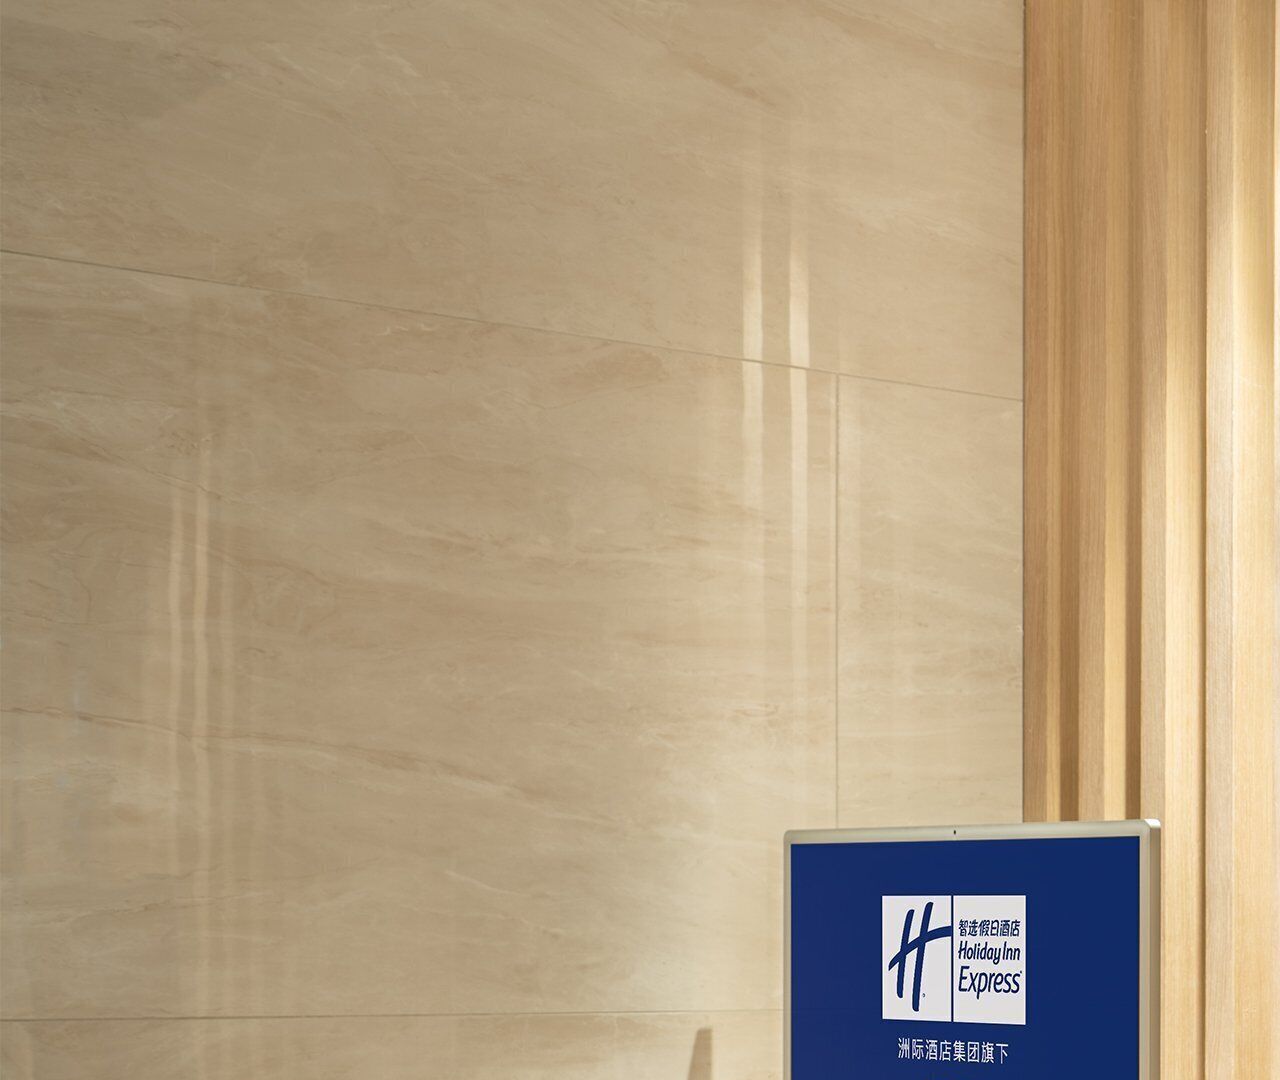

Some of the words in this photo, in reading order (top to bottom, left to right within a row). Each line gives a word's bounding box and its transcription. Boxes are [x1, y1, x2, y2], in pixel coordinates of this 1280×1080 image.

[958, 918, 1021, 938] 智选假日酒店
[958, 940, 1001, 965] Holiday
[1002, 941, 1021, 961] Inn
[958, 965, 1021, 1000] Express
[897, 1037, 1009, 1064] 洲际酒店集团旗下
